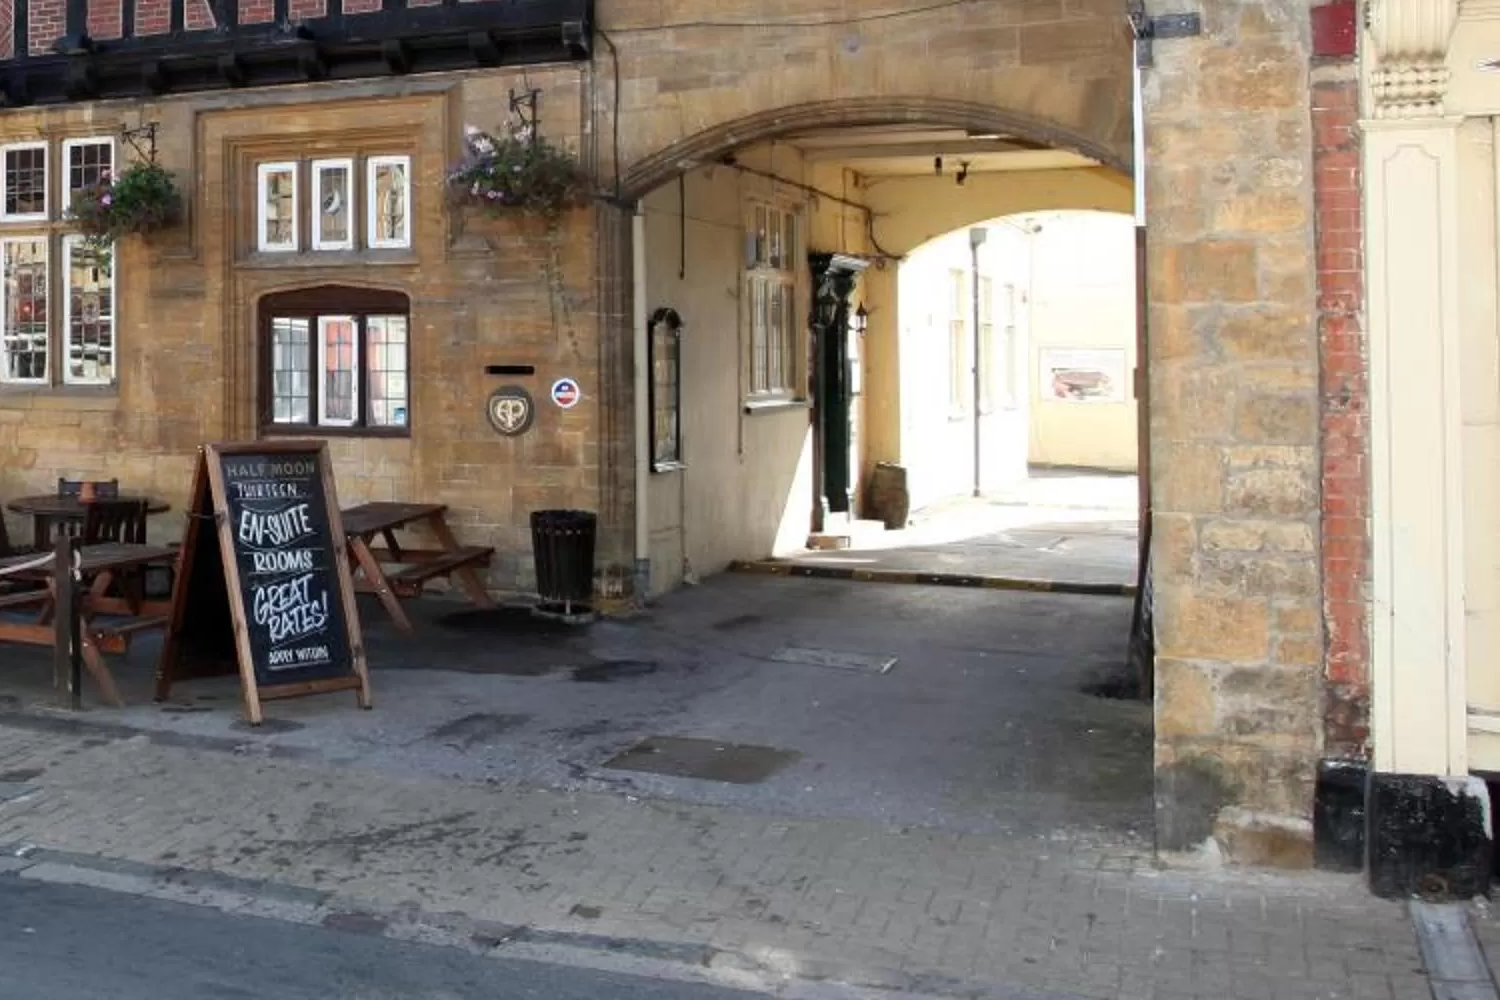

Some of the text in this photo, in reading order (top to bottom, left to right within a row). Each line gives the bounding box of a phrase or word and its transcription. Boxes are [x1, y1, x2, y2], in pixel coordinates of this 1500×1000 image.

[226, 461, 315, 477] HALF MOON
[239, 503, 313, 545] EN-SUITE
[253, 550, 314, 572] ROOMS
[254, 573, 313, 625] GREAT
[268, 590, 328, 643] RATES!
